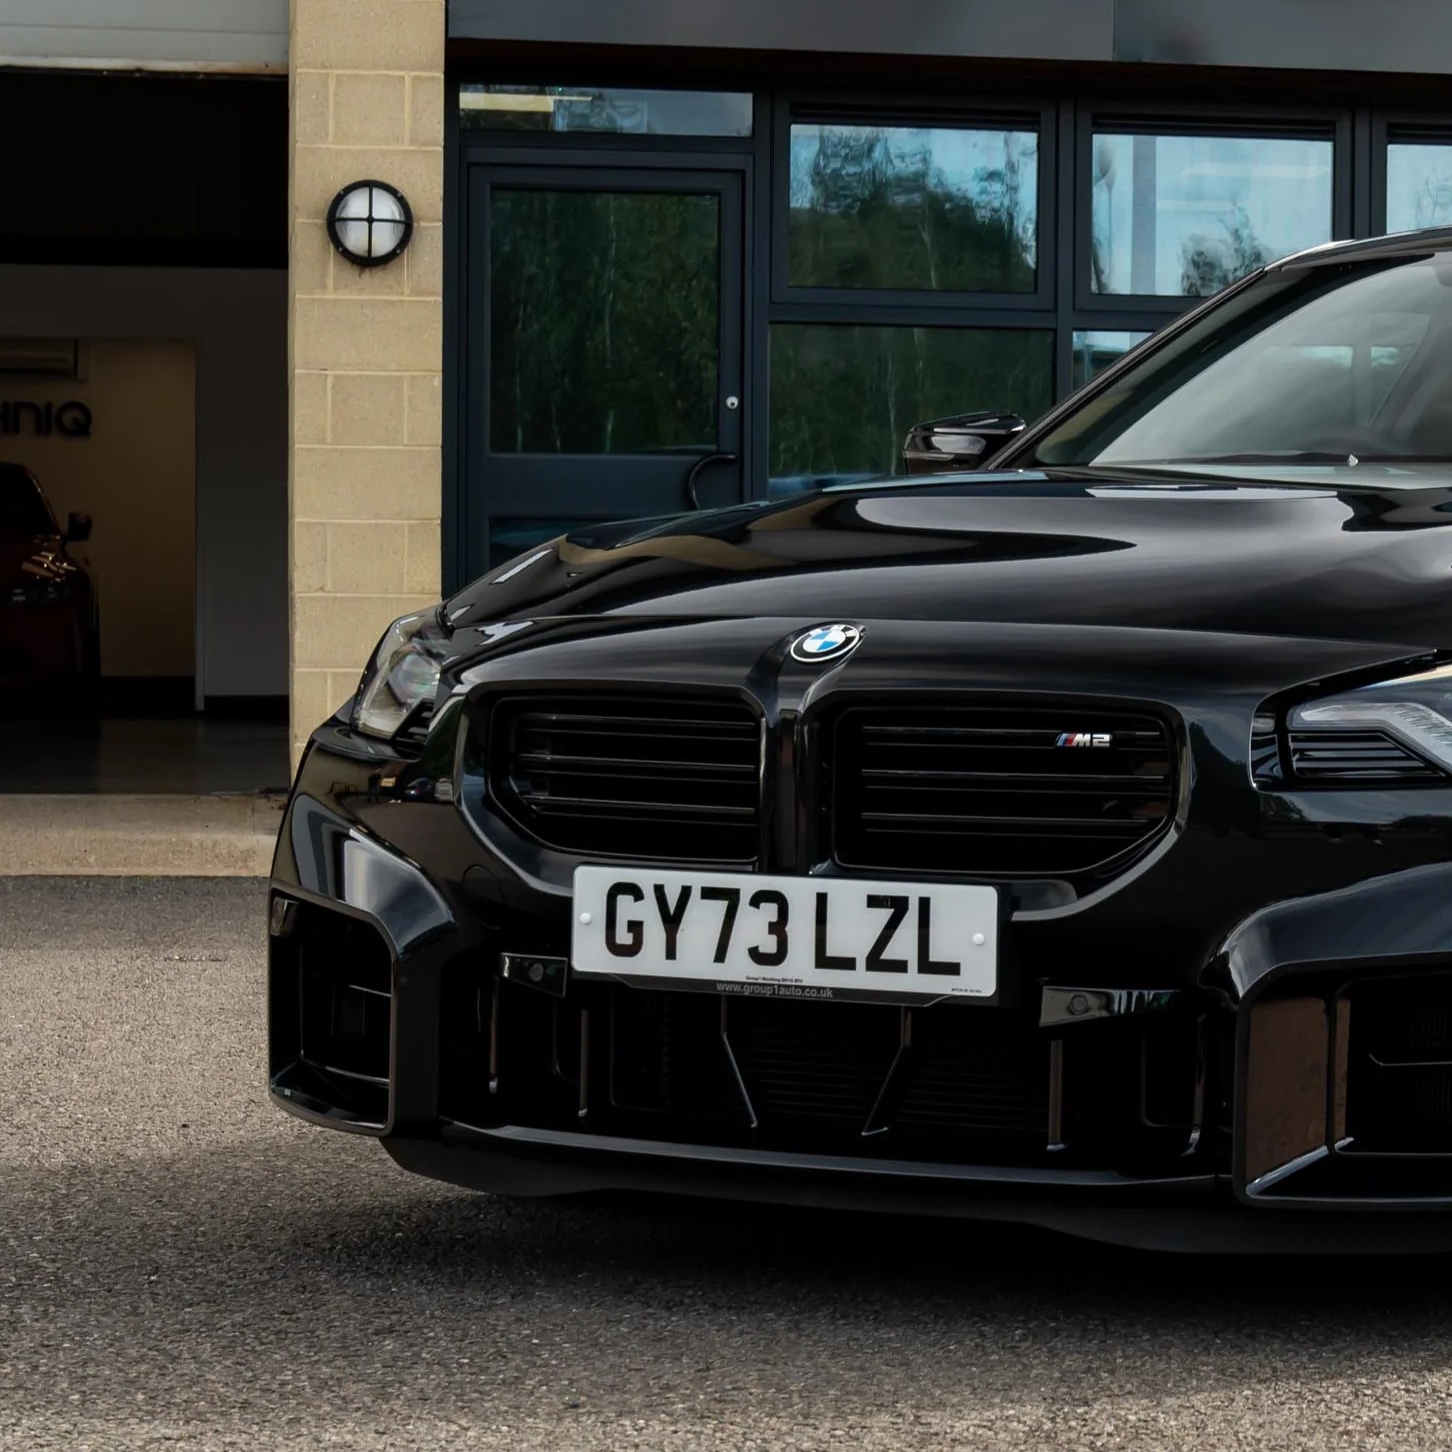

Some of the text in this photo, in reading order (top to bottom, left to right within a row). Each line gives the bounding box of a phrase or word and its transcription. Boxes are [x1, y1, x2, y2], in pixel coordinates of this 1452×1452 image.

[1071, 733, 1111, 747] M2
[605, 881, 961, 976] GY73 LZL
[716, 982, 833, 998] www.group1auto.co.uk
